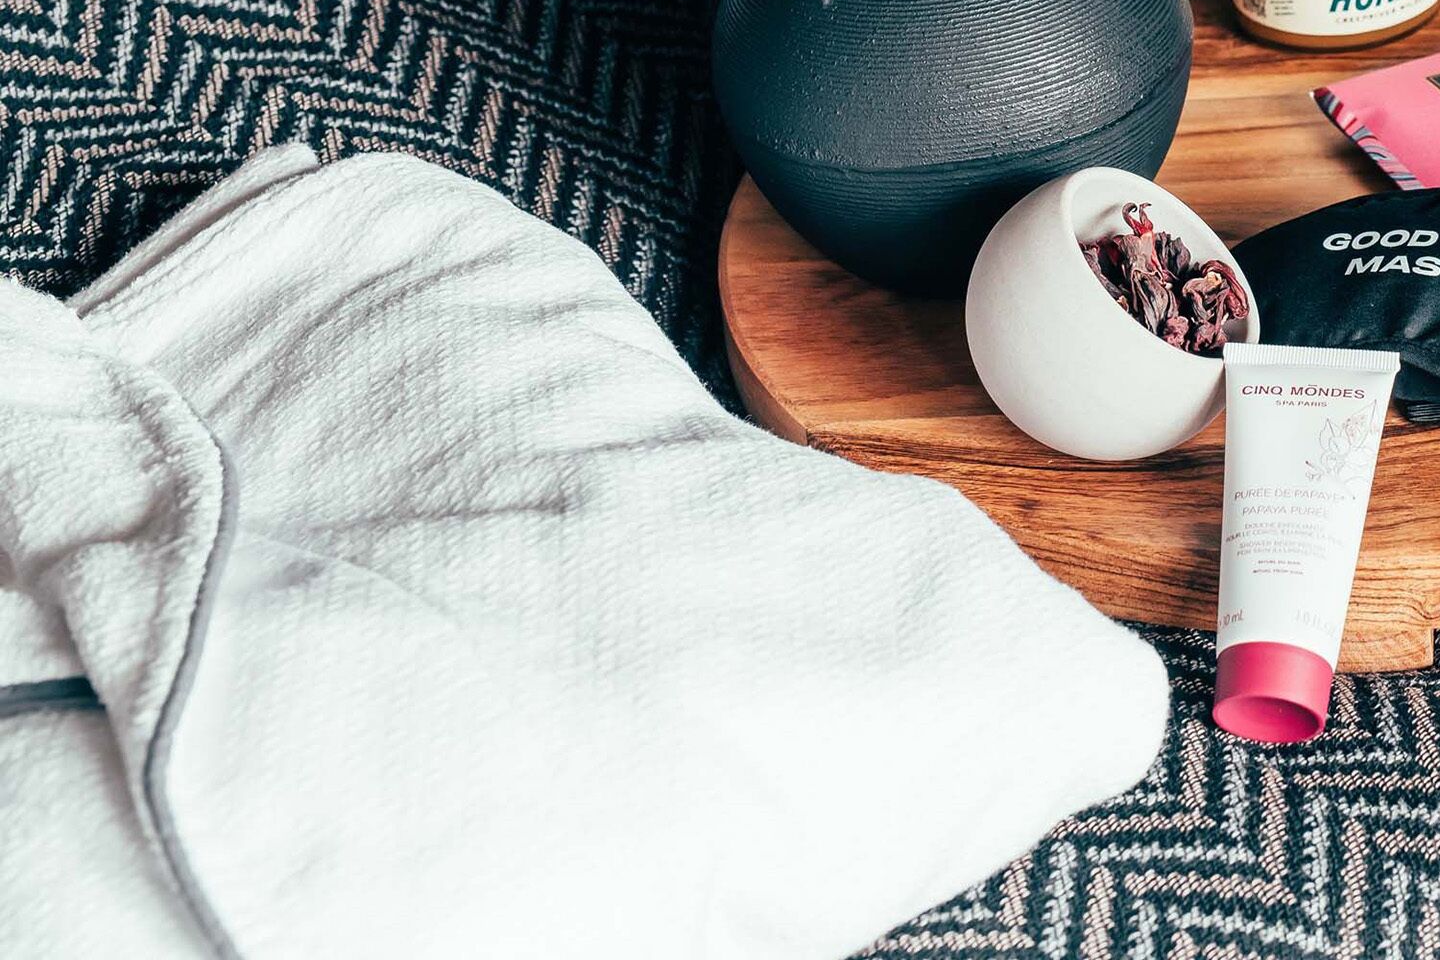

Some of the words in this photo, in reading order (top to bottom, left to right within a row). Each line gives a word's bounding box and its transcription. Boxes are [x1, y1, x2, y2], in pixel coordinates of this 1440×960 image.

[1322, 229, 1439, 251] GOOD
[1242, 385, 1283, 396] CINQ
[1242, 505, 1287, 516] PAPAYA
